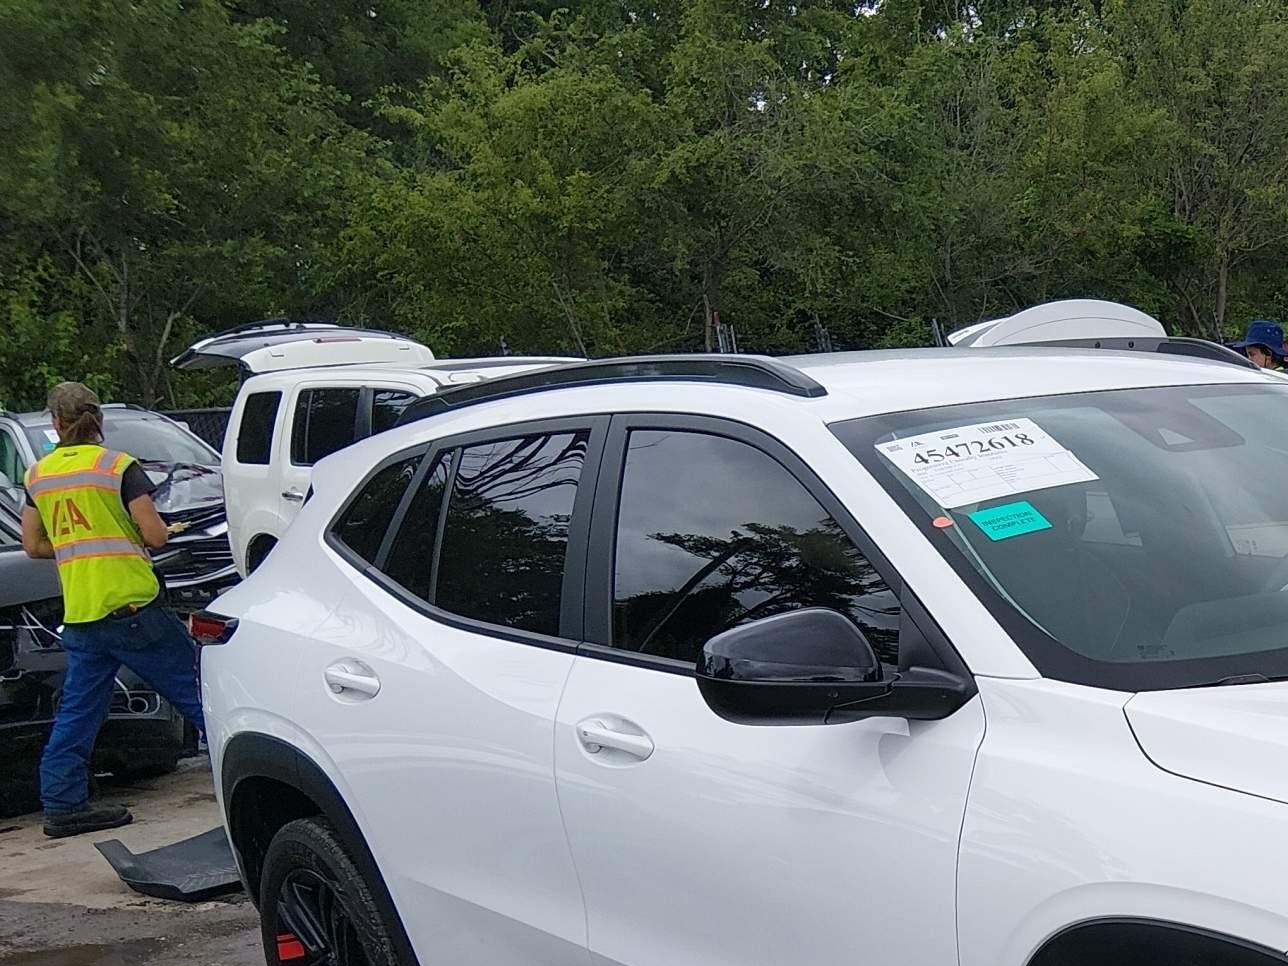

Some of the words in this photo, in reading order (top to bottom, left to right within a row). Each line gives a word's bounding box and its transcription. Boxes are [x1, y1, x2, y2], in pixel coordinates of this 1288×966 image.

[914, 433, 1035, 465] 45472618
[981, 511, 1033, 527] INSPECTION
[991, 517, 1037, 531] COMPLETE
